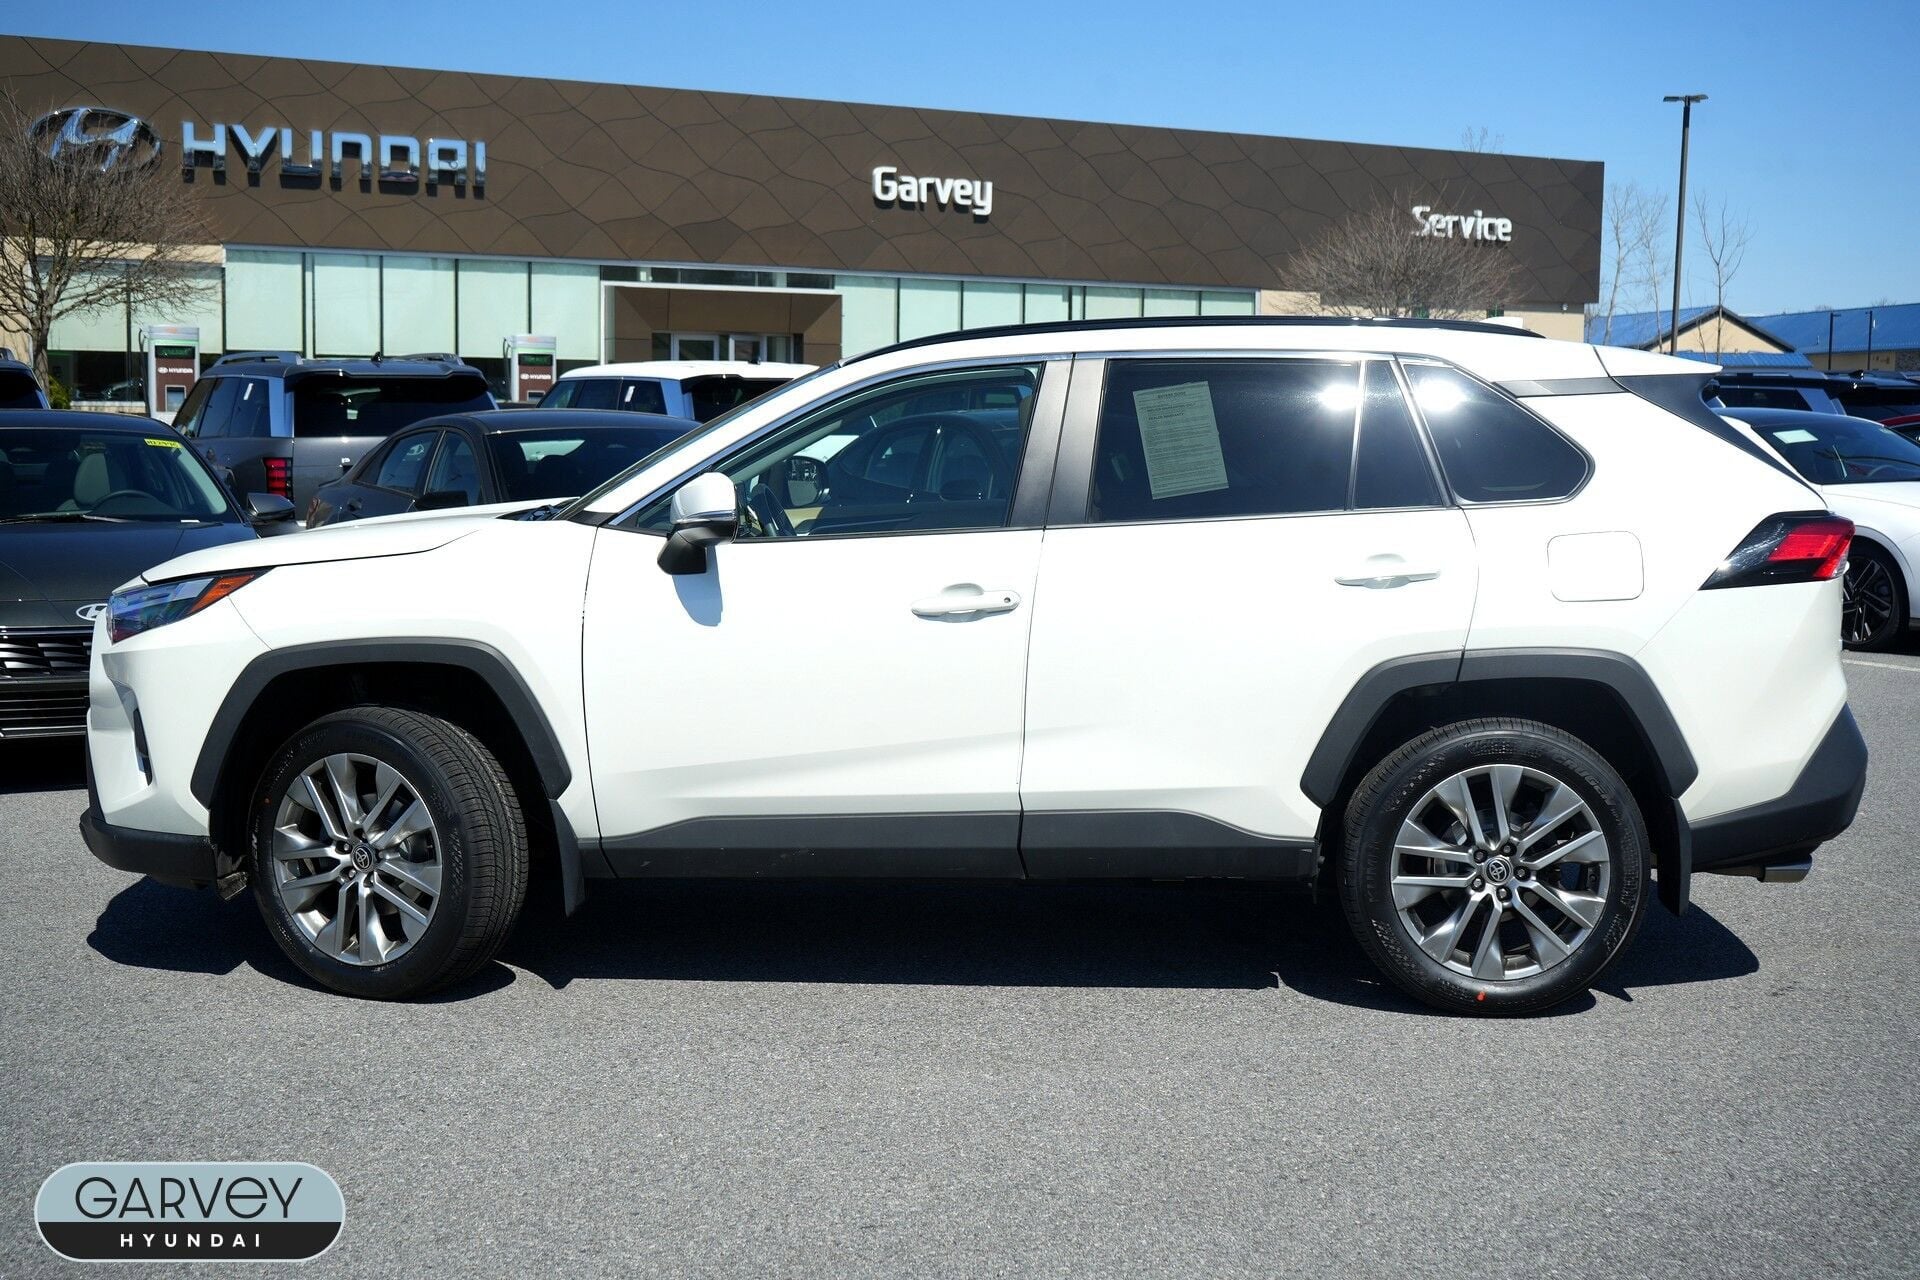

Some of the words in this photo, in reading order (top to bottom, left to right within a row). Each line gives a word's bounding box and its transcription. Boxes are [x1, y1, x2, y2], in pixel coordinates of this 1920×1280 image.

[182, 120, 486, 186] HYUNDAI
[872, 166, 993, 216] Garvey
[1410, 205, 1513, 242] Service
